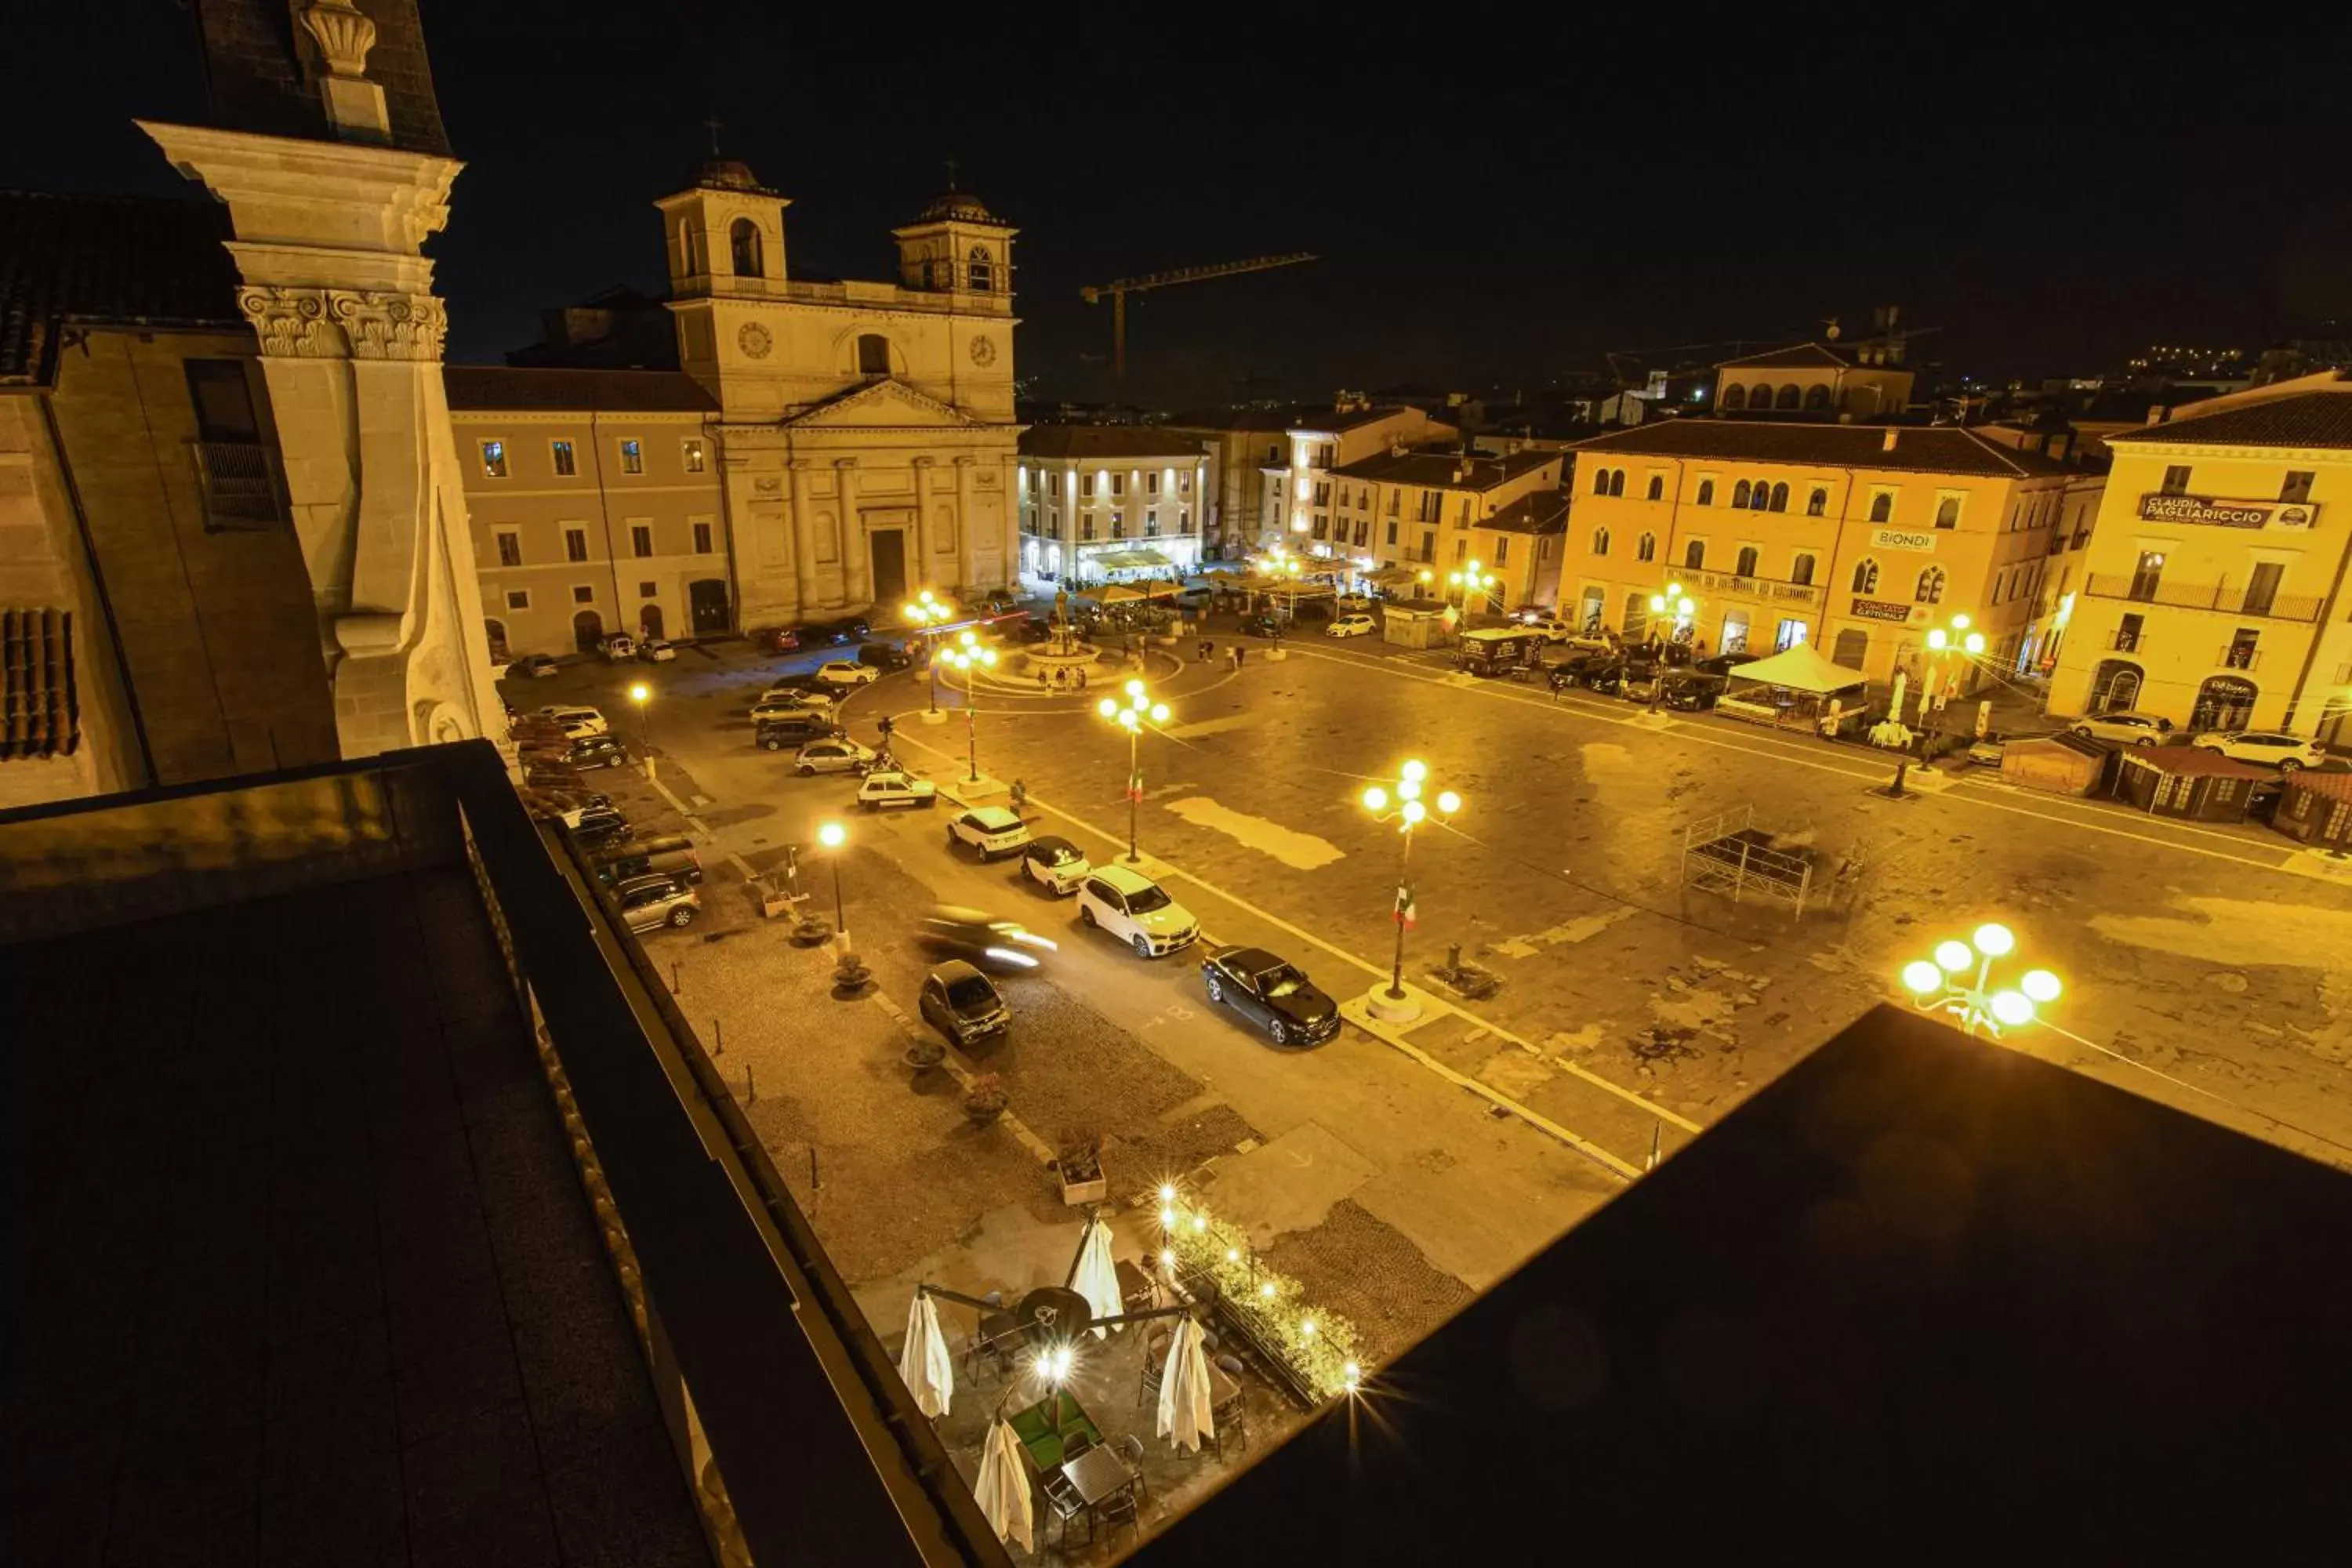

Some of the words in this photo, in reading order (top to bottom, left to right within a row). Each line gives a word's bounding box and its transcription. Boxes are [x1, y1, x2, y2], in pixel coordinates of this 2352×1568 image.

[2148, 497, 2202, 510] CLAUDIA
[2146, 505, 2262, 524] PAGLIARICCIO
[1879, 531, 1930, 546] BIONDI
